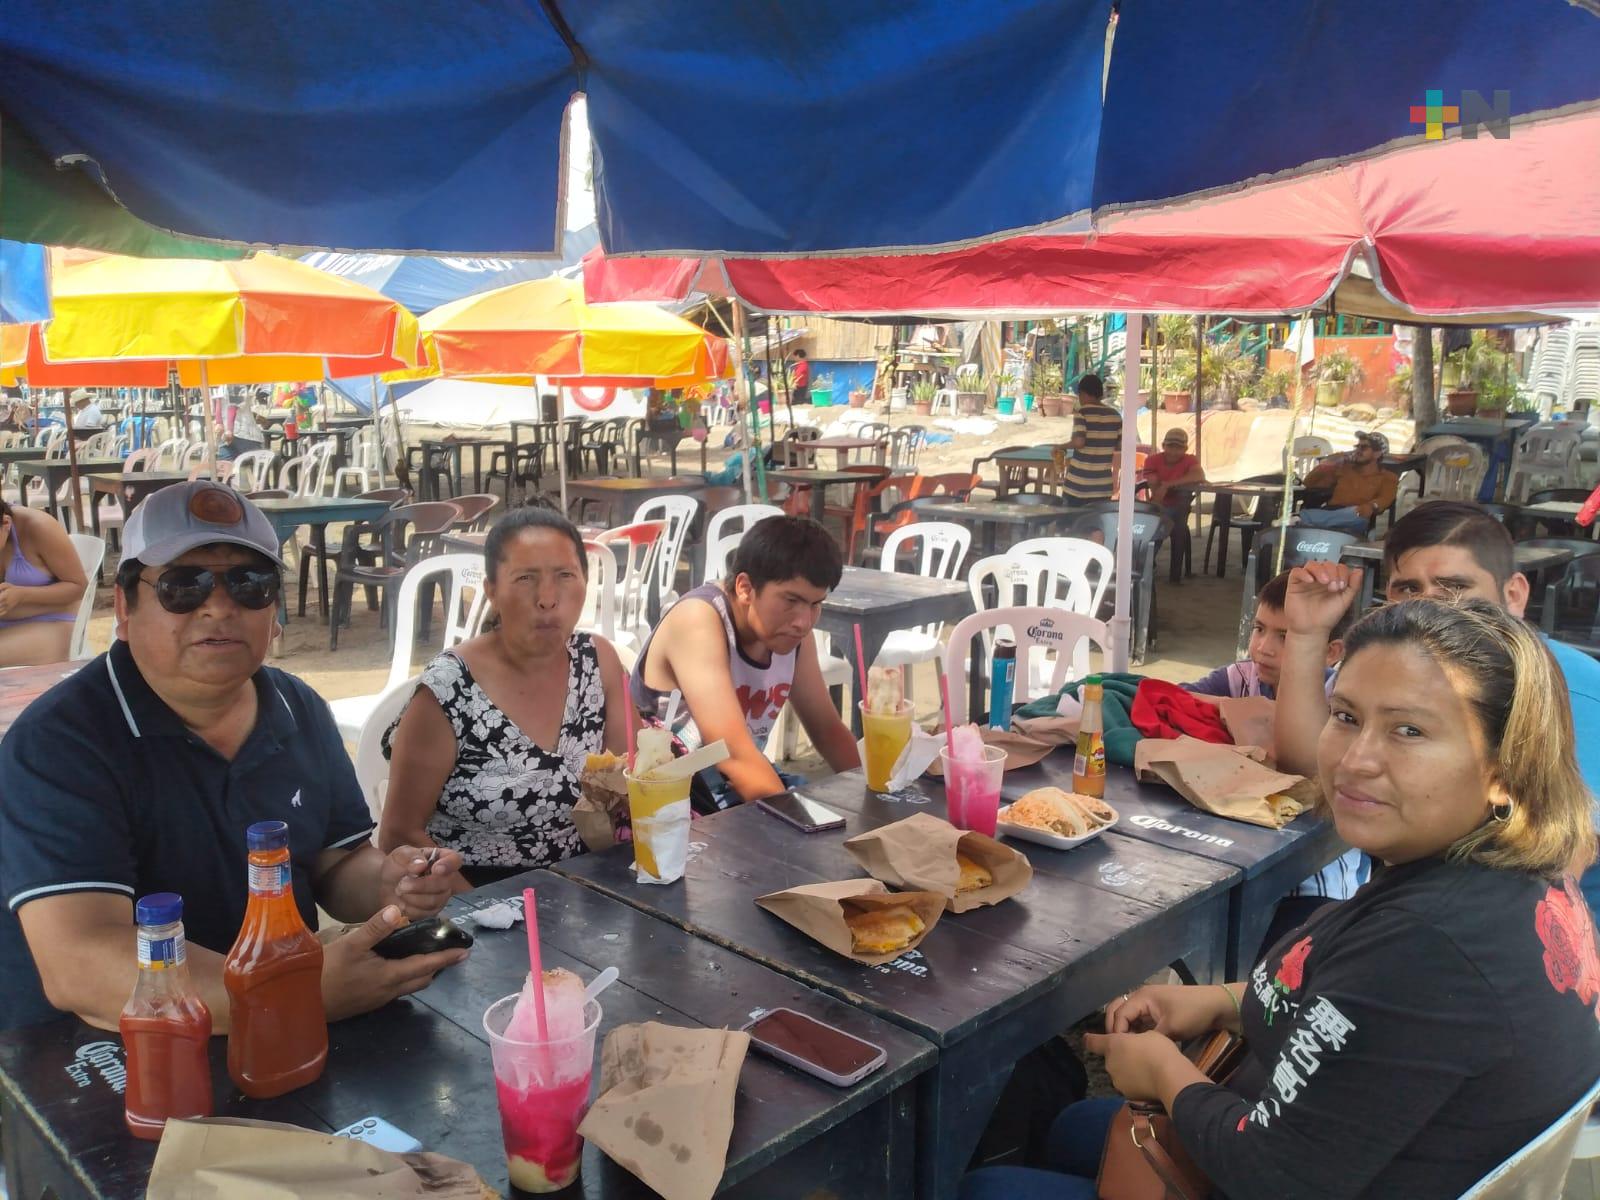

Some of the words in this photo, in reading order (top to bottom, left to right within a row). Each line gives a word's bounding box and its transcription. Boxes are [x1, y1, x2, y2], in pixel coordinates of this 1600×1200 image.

[1027, 625, 1063, 641] Corona
[1130, 815, 1235, 848] Corona
[64, 1061, 92, 1088] Extra
